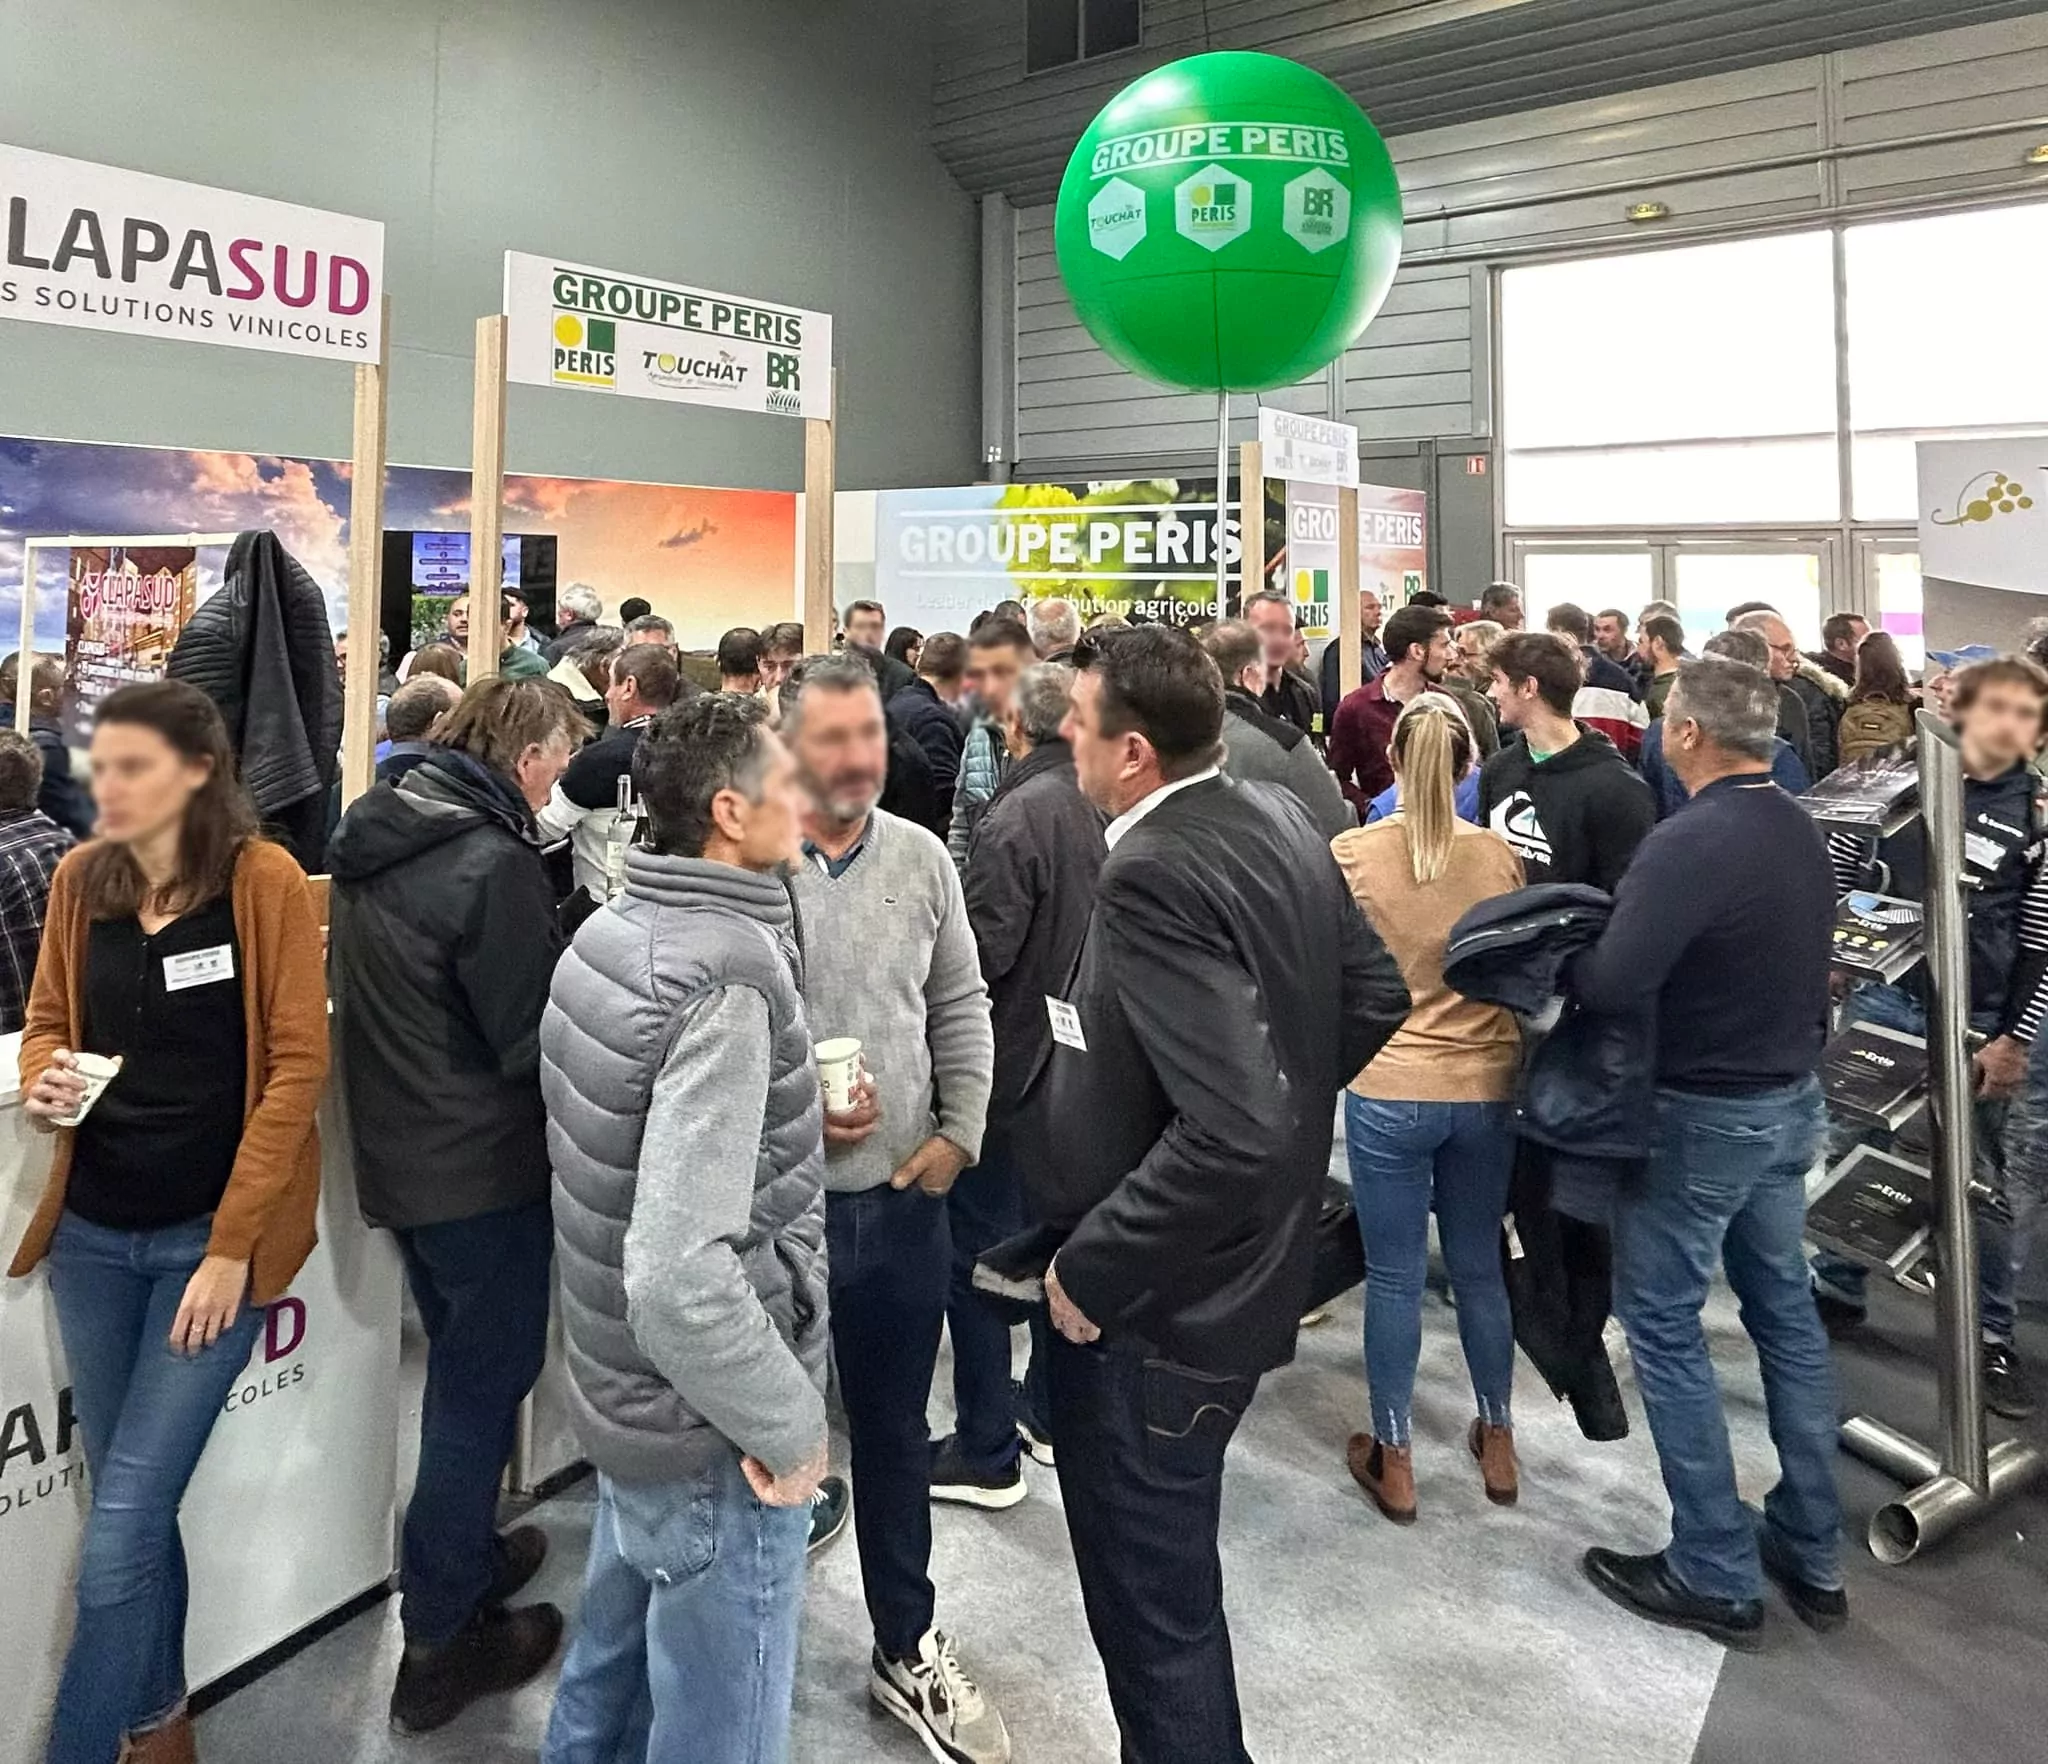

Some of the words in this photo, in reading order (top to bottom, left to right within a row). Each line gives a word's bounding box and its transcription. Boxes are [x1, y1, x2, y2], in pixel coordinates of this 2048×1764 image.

[1090, 126, 1231, 174] GROUPE
[1241, 126, 1349, 162] PERIS
[1090, 208, 1142, 229] TOUCHAT
[1191, 206, 1236, 222] PERIS
[1303, 186, 1334, 218] BR
[35, 286, 214, 328] SOLUTIONS
[228, 313, 368, 348] VINICOLES
[553, 274, 703, 328] GROUPE
[712, 303, 802, 346] PERIS
[553, 348, 615, 376] PERIS
[643, 350, 748, 383] TOUCHAT
[766, 351, 801, 391] BR
[1274, 415, 1318, 441] GROUPE
[1319, 425, 1348, 448] PERIS
[900, 523, 1078, 564] GROUPE
[1089, 519, 1242, 564] PERIS
[1375, 515, 1422, 545] PERIS
[101, 574, 177, 611] CLAPASUD
[1296, 604, 1329, 627] PERIS
